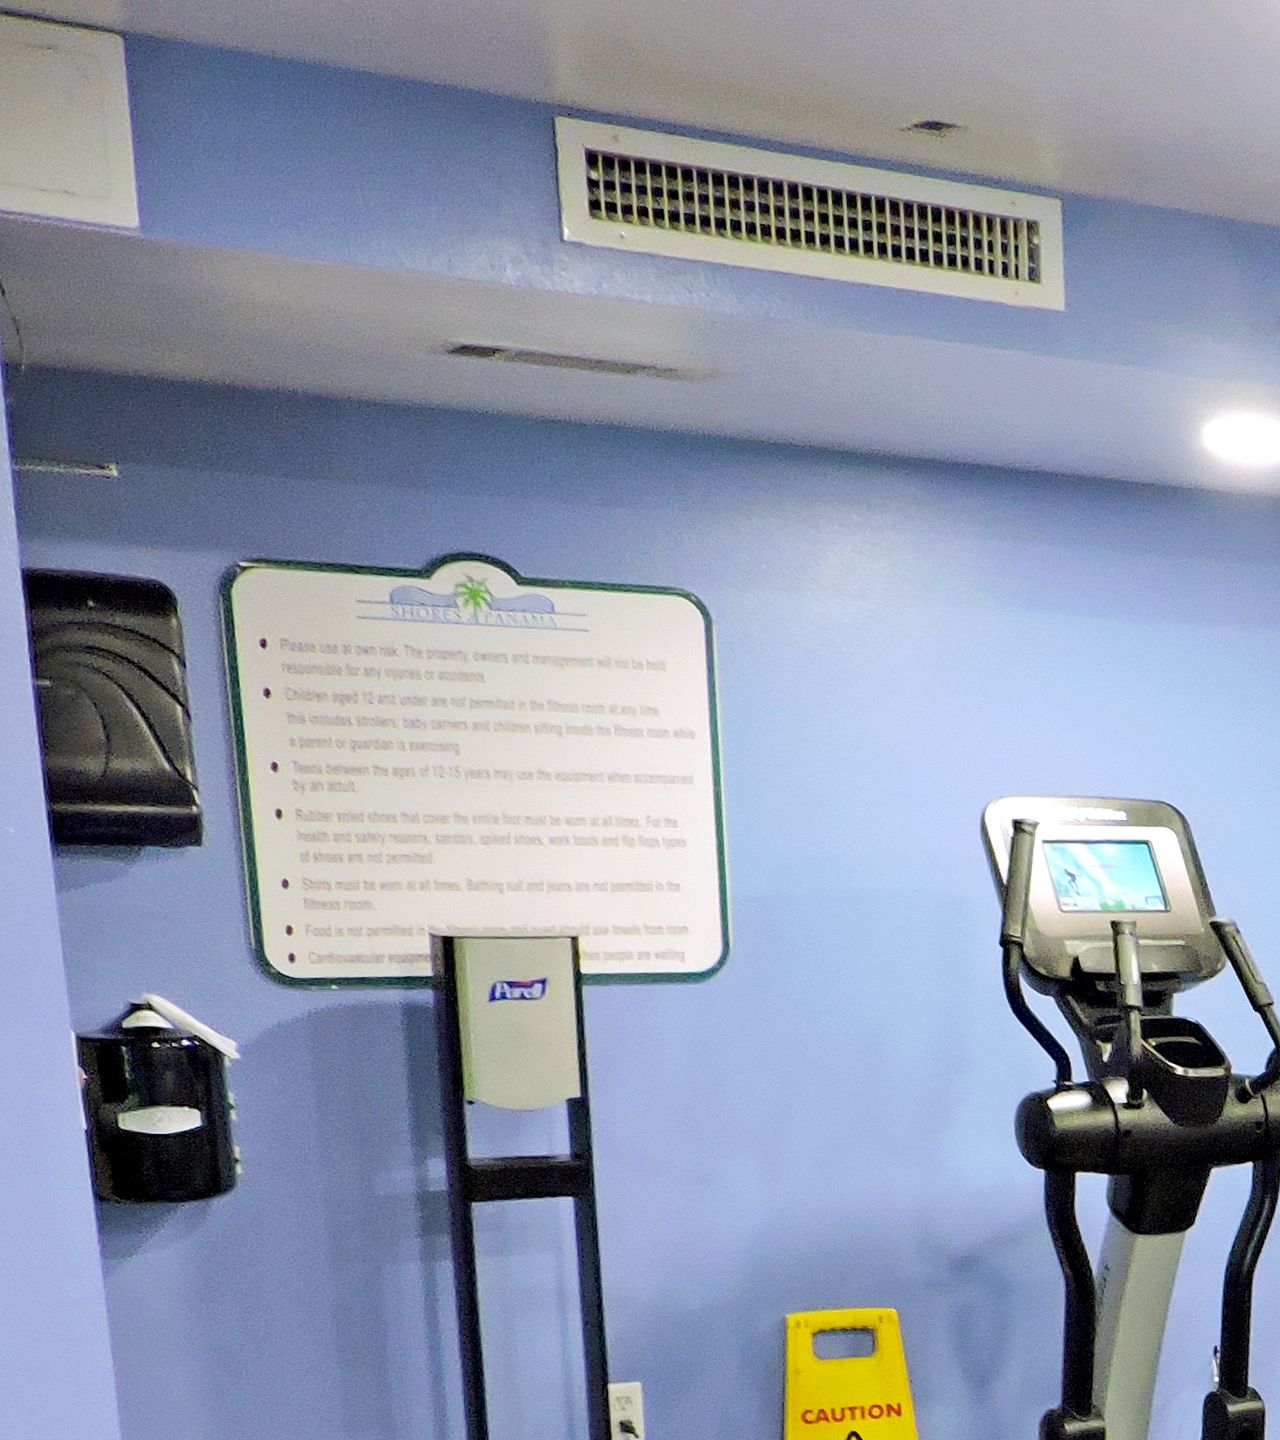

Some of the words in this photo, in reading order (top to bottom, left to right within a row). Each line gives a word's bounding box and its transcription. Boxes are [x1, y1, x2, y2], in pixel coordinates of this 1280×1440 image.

[389, 604, 462, 621] SHORES
[484, 611, 558, 628] PANAMA
[280, 638, 316, 653] Please
[404, 645, 423, 658] The
[285, 687, 328, 701] Children
[295, 808, 332, 822] Rubber
[646, 815, 661, 827] For
[302, 878, 332, 891] Shirts
[305, 924, 332, 937] Food
[800, 1402, 902, 1424] CAUTION
